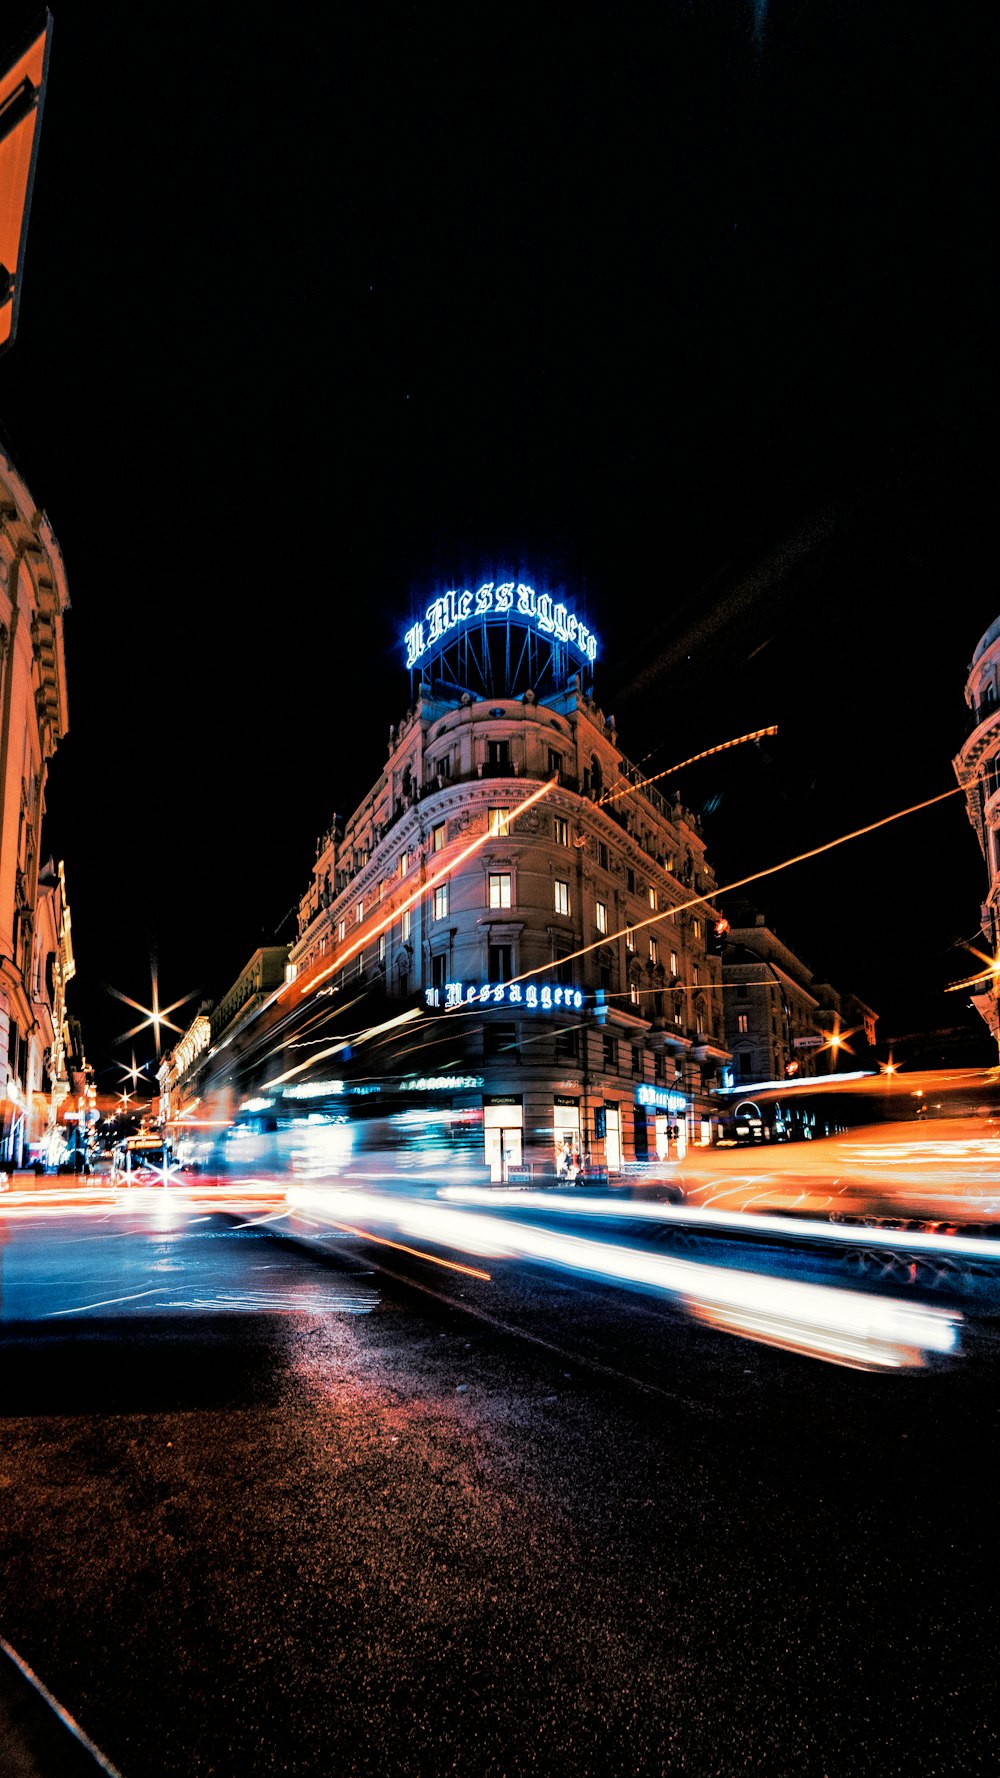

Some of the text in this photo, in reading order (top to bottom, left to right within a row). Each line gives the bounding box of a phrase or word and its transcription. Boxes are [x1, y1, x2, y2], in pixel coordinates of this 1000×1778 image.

[404, 582, 598, 669] Il Messaggero
[425, 982, 583, 1009] Il Messaggero
